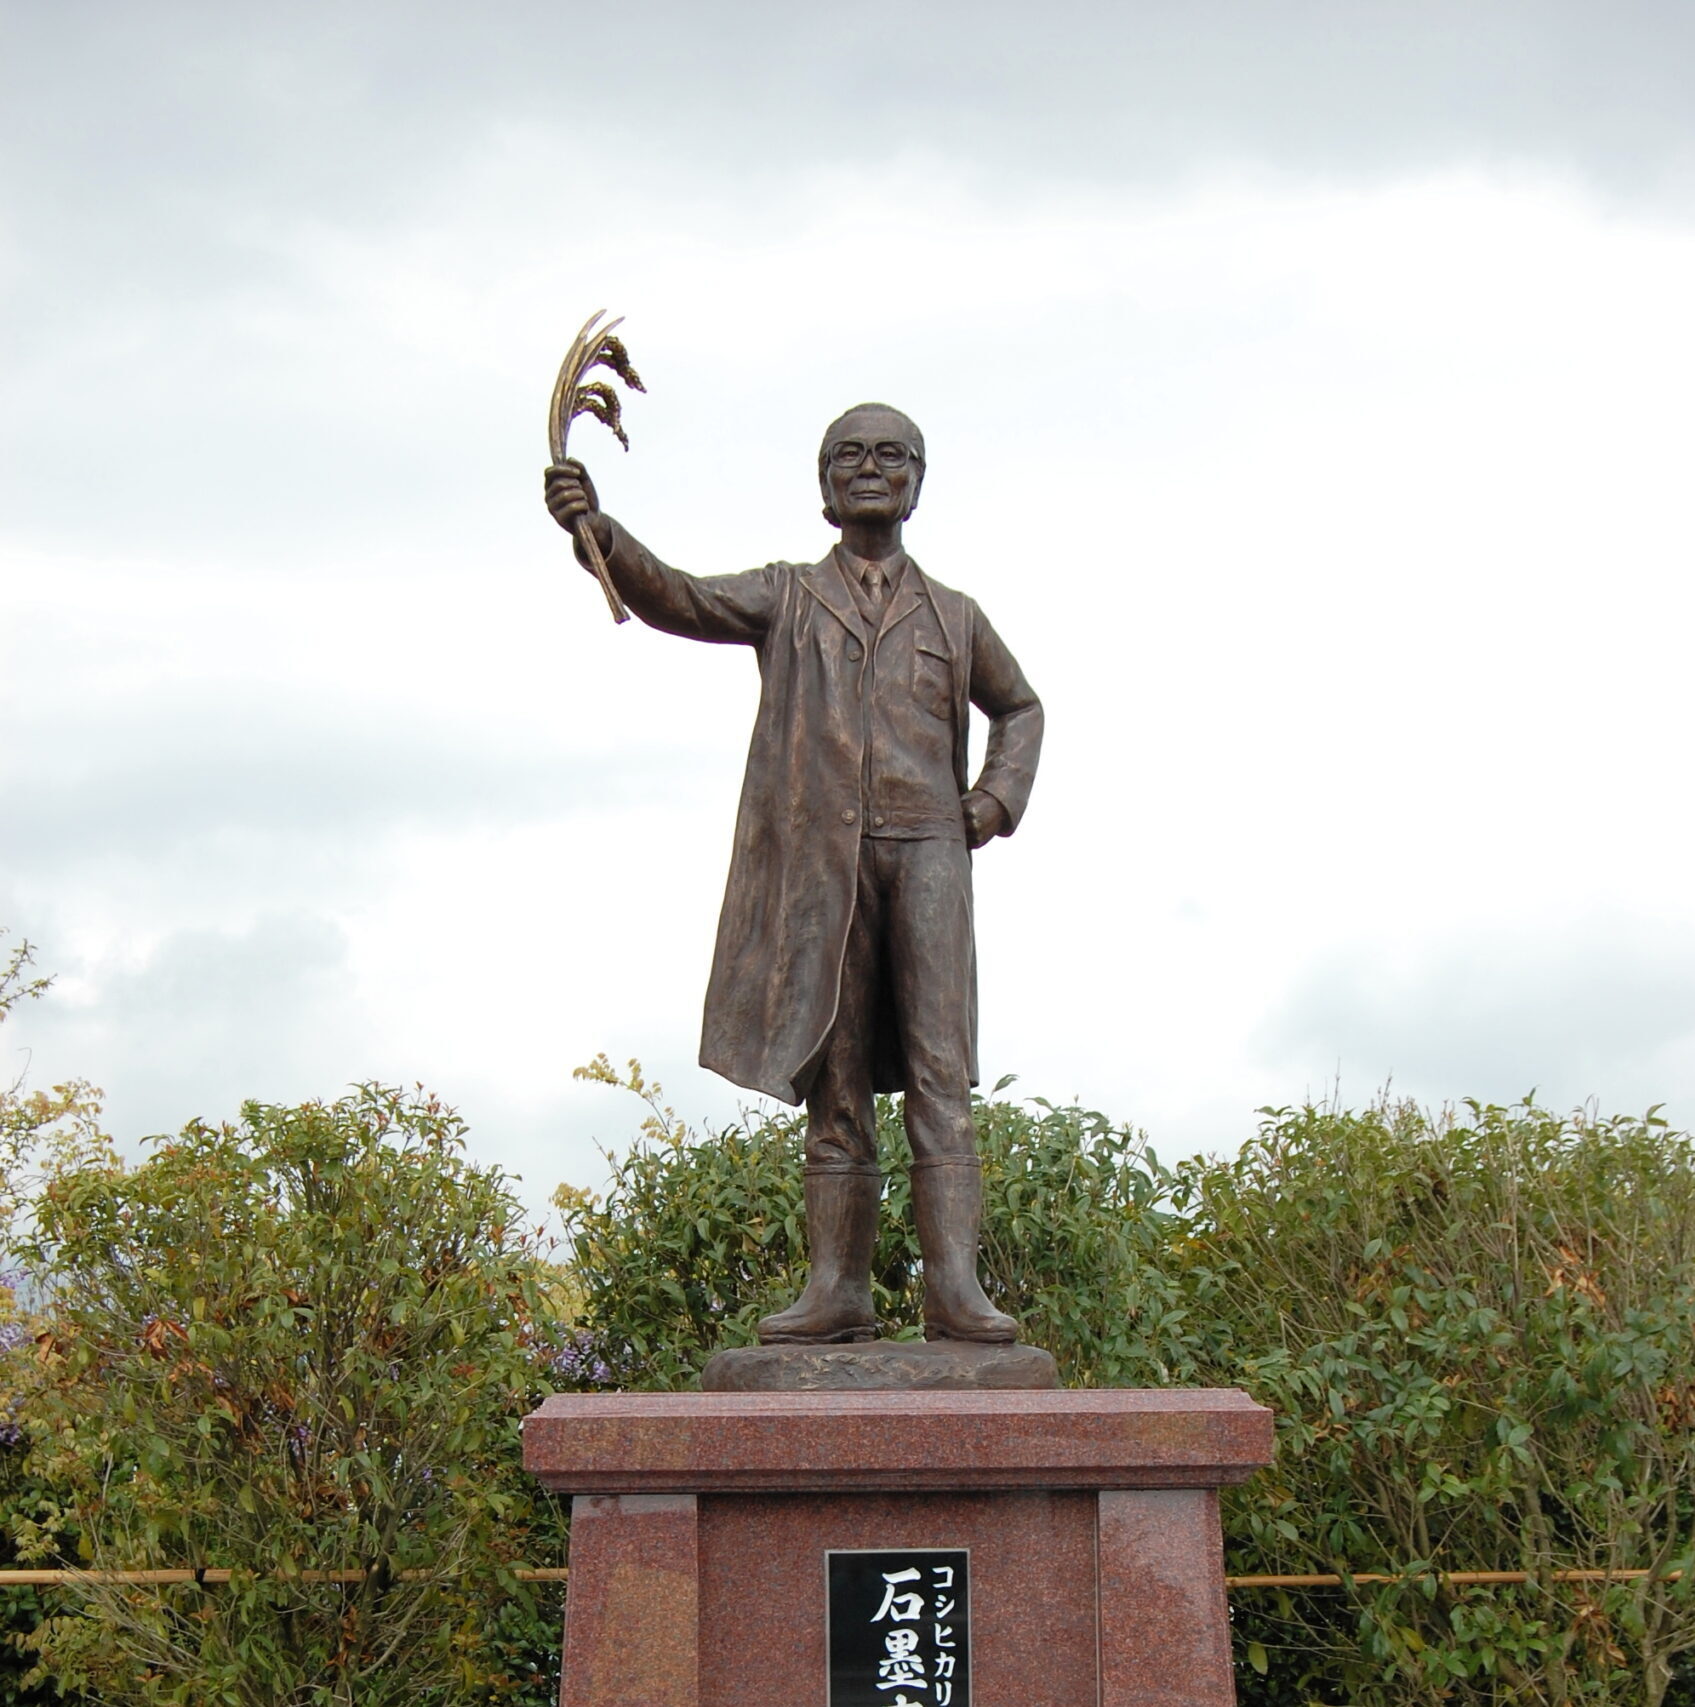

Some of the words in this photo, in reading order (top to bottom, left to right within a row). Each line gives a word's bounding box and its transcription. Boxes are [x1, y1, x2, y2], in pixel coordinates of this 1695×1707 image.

[869, 1567, 928, 1707] 石墨
[932, 1566, 956, 1706] コシヒカリ
